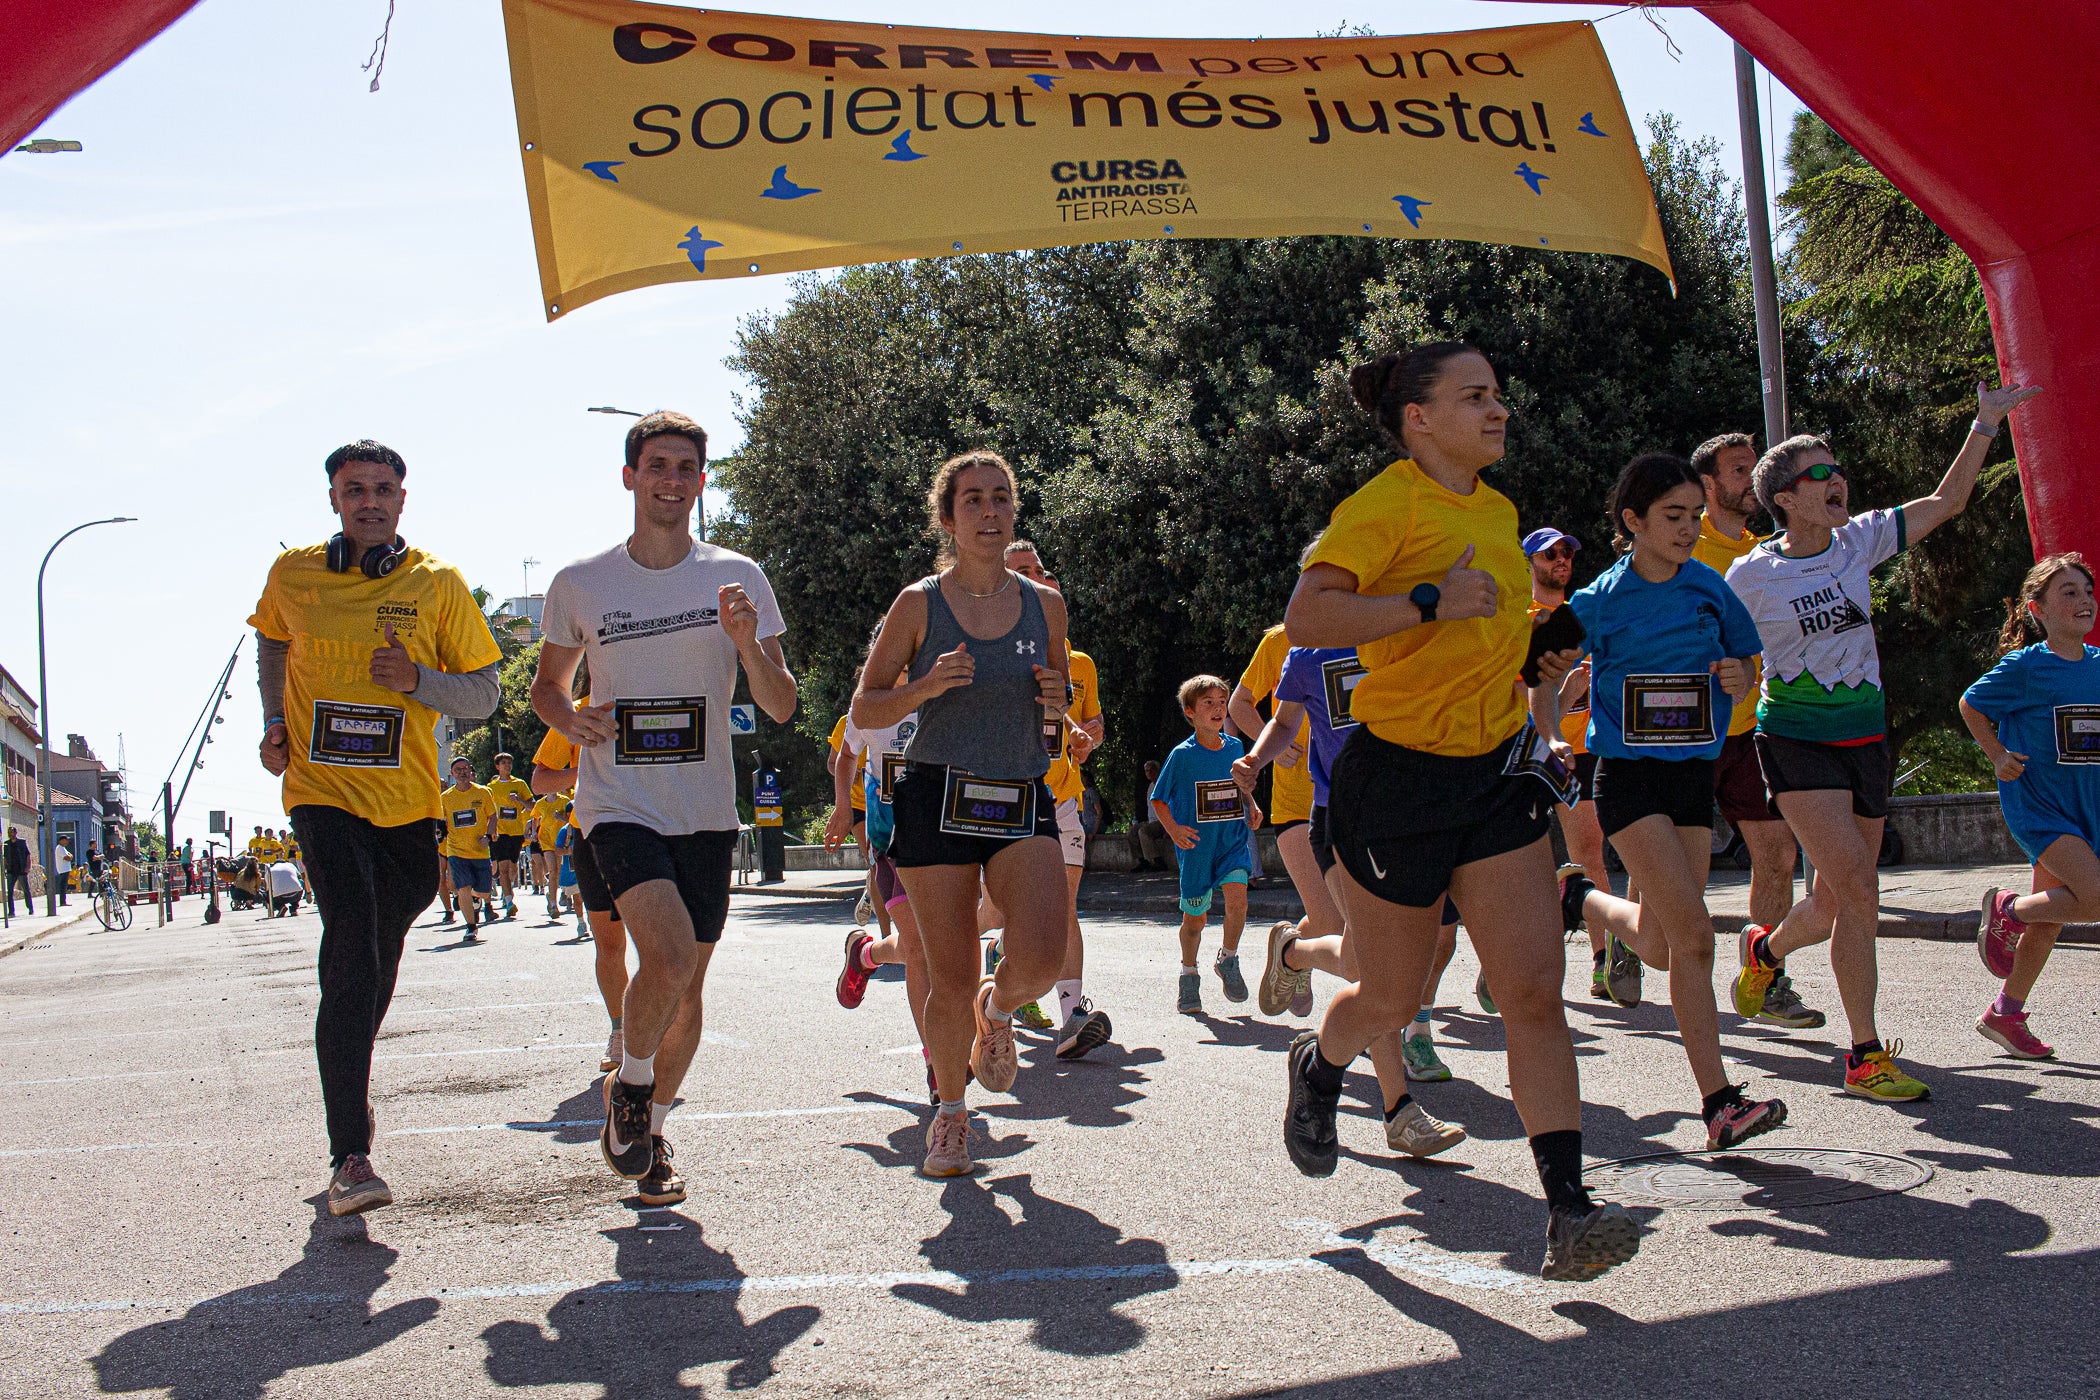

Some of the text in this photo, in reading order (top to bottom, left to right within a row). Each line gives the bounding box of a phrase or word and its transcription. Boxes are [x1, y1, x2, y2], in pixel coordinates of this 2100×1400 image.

[613, 22, 1524, 79] CORREM per una
[628, 76, 1557, 157] societat més justa!
[1050, 159, 1187, 183] CURSA
[1056, 197, 1198, 222] TERRASSA
[1789, 587, 1840, 614] TRAIL
[377, 606, 418, 617] CURSA
[1652, 711, 1689, 727] 428
[339, 736, 374, 752] 395
[643, 733, 680, 748] 053
[766, 775, 774, 785] P
[970, 803, 1007, 820] 499
